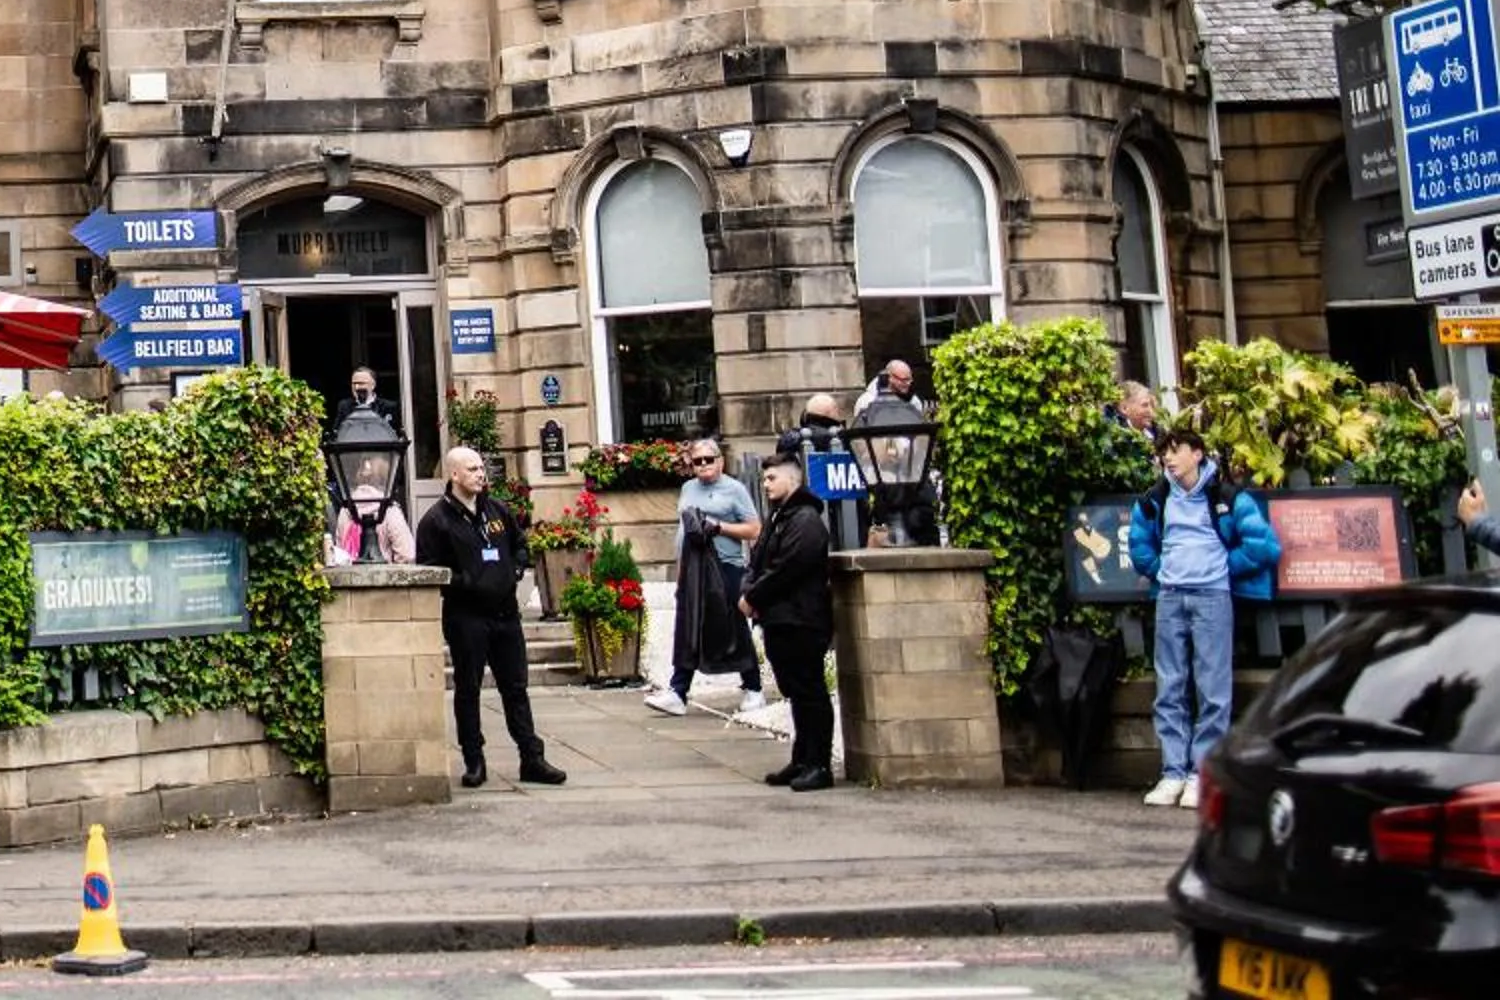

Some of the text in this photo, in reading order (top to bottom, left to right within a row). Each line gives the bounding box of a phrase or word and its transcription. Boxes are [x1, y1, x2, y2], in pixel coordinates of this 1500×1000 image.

[1409, 99, 1431, 120] taxi
[1429, 133, 1455, 153] Mon
[1463, 125, 1479, 145] Fri
[1416, 158, 1443, 179] 7.30
[1450, 150, 1478, 173] 9.30
[1418, 179, 1446, 200] 4.00
[1453, 172, 1481, 193] 6.30
[124, 219, 195, 242] TOILETS
[277, 231, 389, 255] MURRAYFIELD
[1415, 234, 1475, 258] Bus lane
[1419, 261, 1477, 285] cameras
[153, 288, 219, 304] ADDITIONAL
[139, 303, 234, 321] SEATING & BARS
[134, 338, 234, 358] BELLFIELD BAR
[826, 462, 866, 491] MA
[43, 574, 153, 609] GRADUATES!
